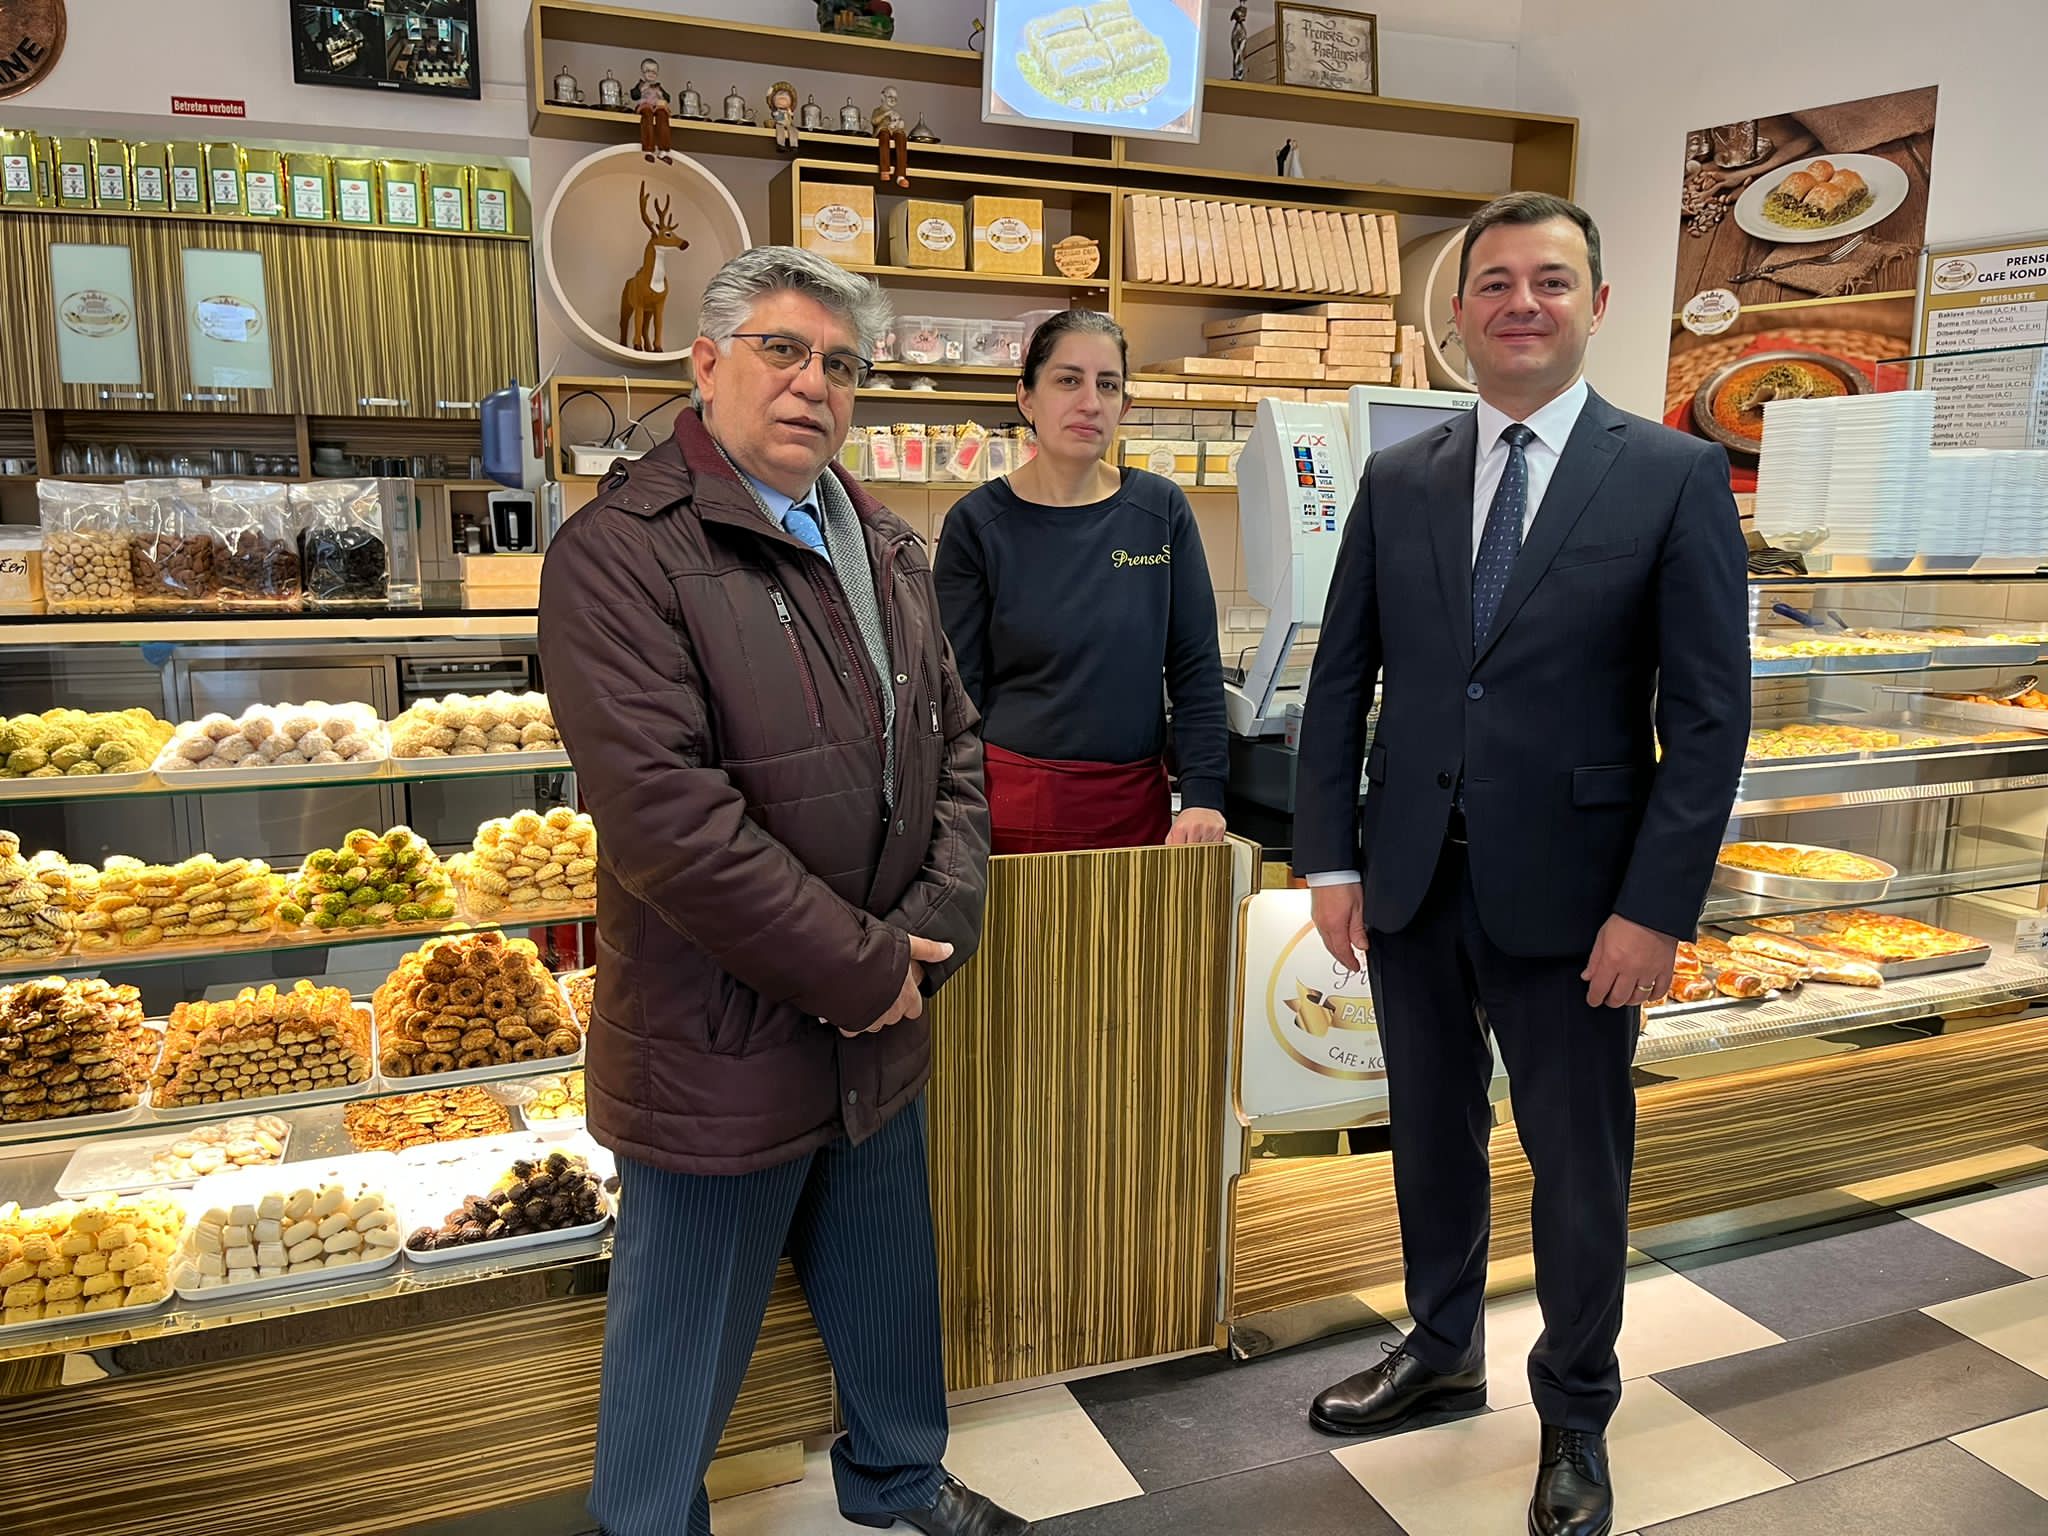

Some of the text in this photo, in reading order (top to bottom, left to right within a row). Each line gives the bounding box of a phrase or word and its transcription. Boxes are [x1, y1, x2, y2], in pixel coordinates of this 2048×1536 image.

[174, 100, 243, 115] Betreten verboten
[2006, 253, 2048, 267] PRENS
[1978, 267, 2047, 283] CAFE KOND
[1980, 291, 2036, 304] PREISLISTE
[1294, 434, 1327, 446] SIX
[1341, 1003, 1377, 1025] PAS
[1328, 1046, 1359, 1067] CAFE
